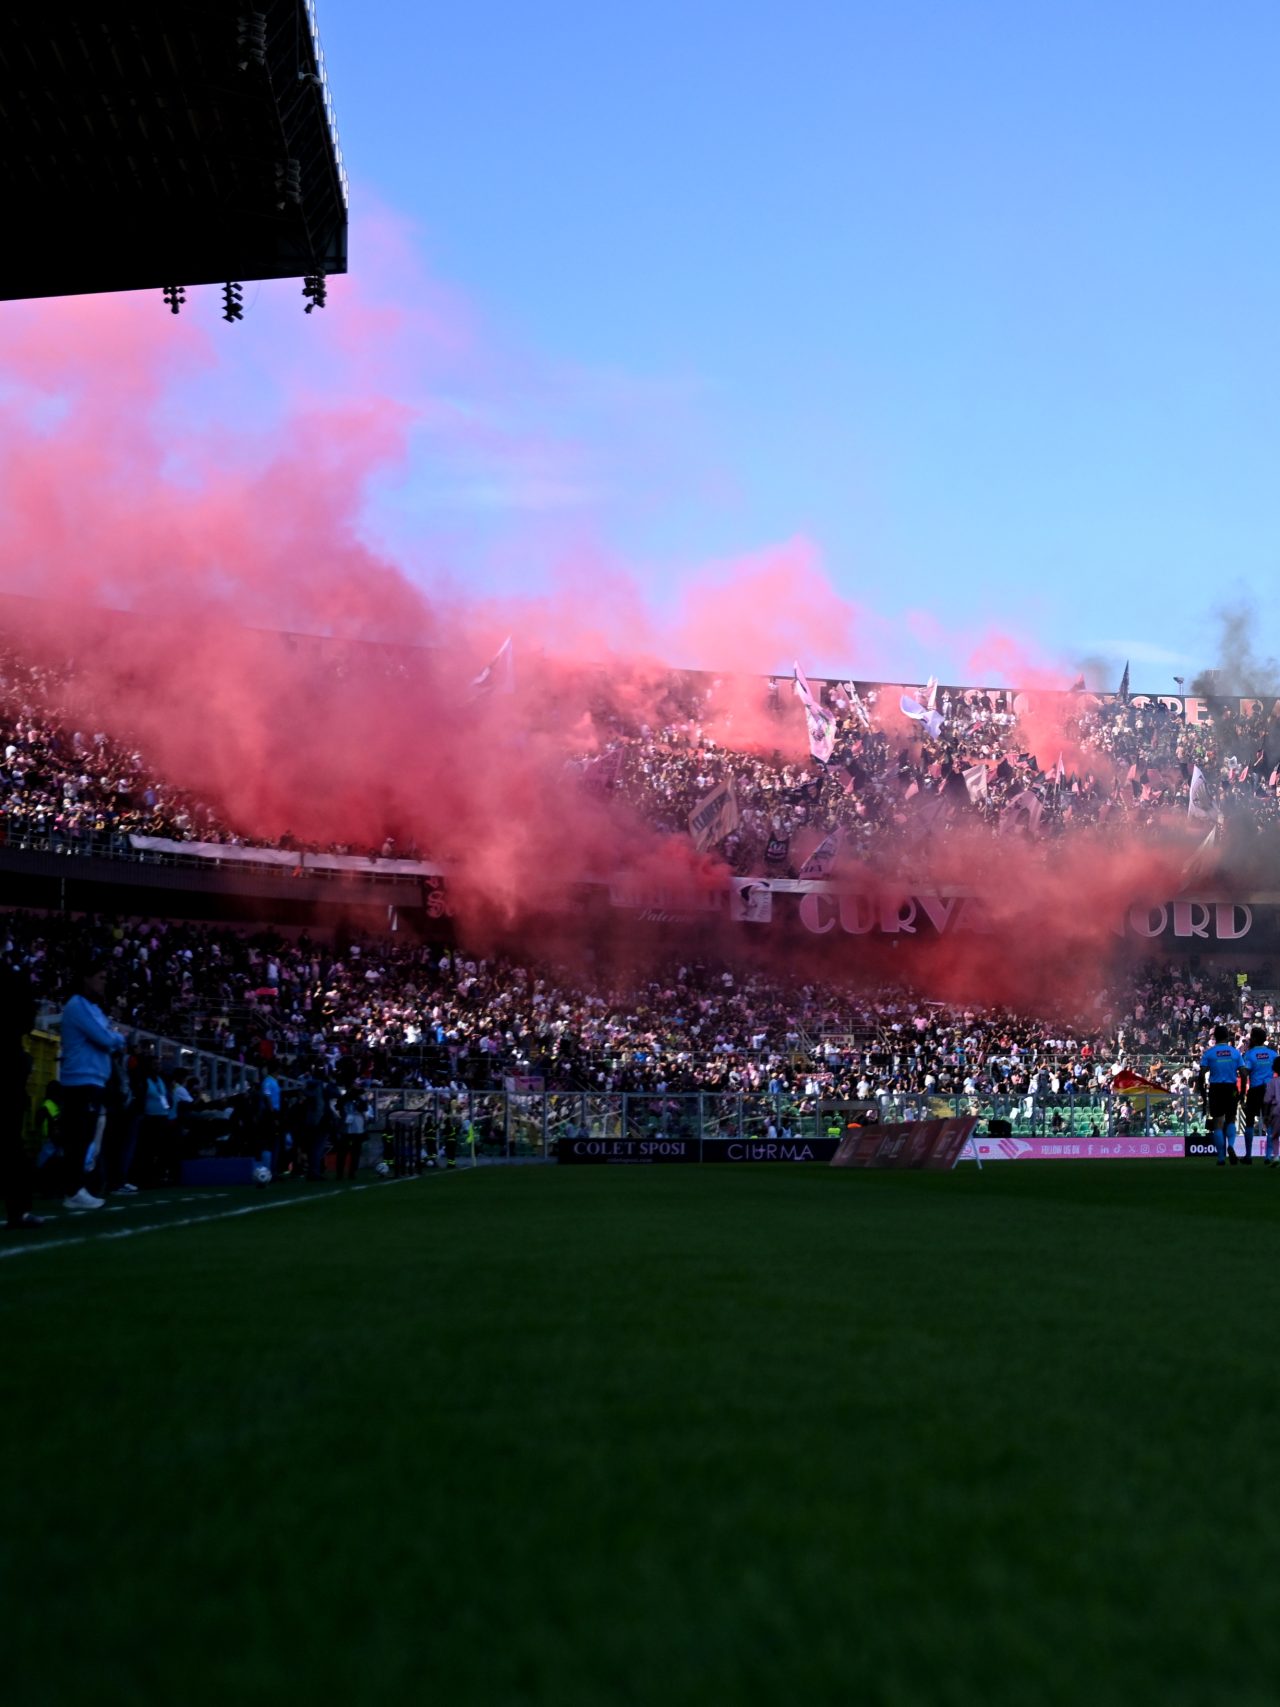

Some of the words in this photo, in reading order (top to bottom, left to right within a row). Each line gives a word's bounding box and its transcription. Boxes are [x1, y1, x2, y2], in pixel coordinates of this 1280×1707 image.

[800, 893, 992, 934] CURVA
[574, 1142, 641, 1156] COLET
[647, 1142, 686, 1156] SPOSI
[728, 1143, 815, 1160] CIURMA
